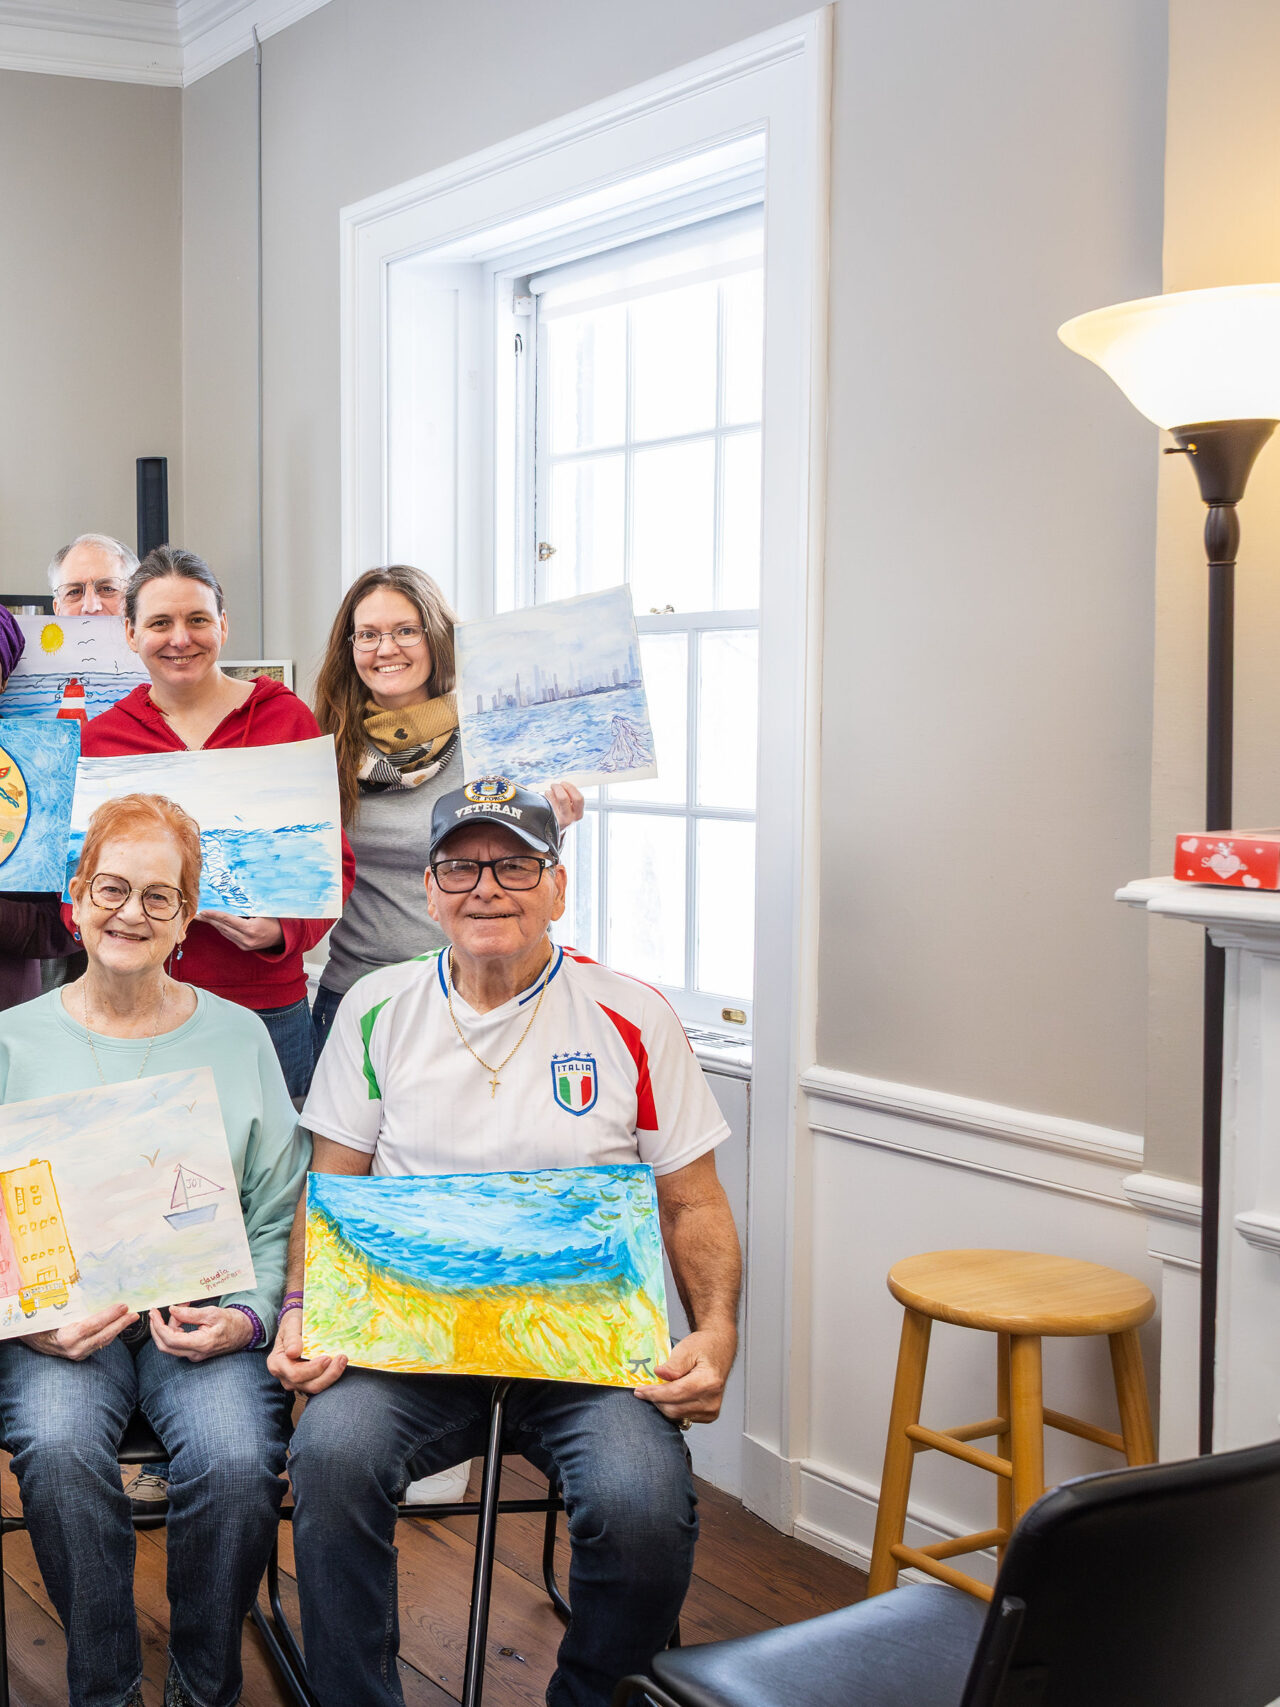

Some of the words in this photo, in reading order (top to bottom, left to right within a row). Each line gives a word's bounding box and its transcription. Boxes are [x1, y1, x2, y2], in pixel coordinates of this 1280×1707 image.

[455, 802, 523, 820] VETERAN
[557, 1063, 592, 1073] ITALIA
[199, 1268, 230, 1286] Claudia
